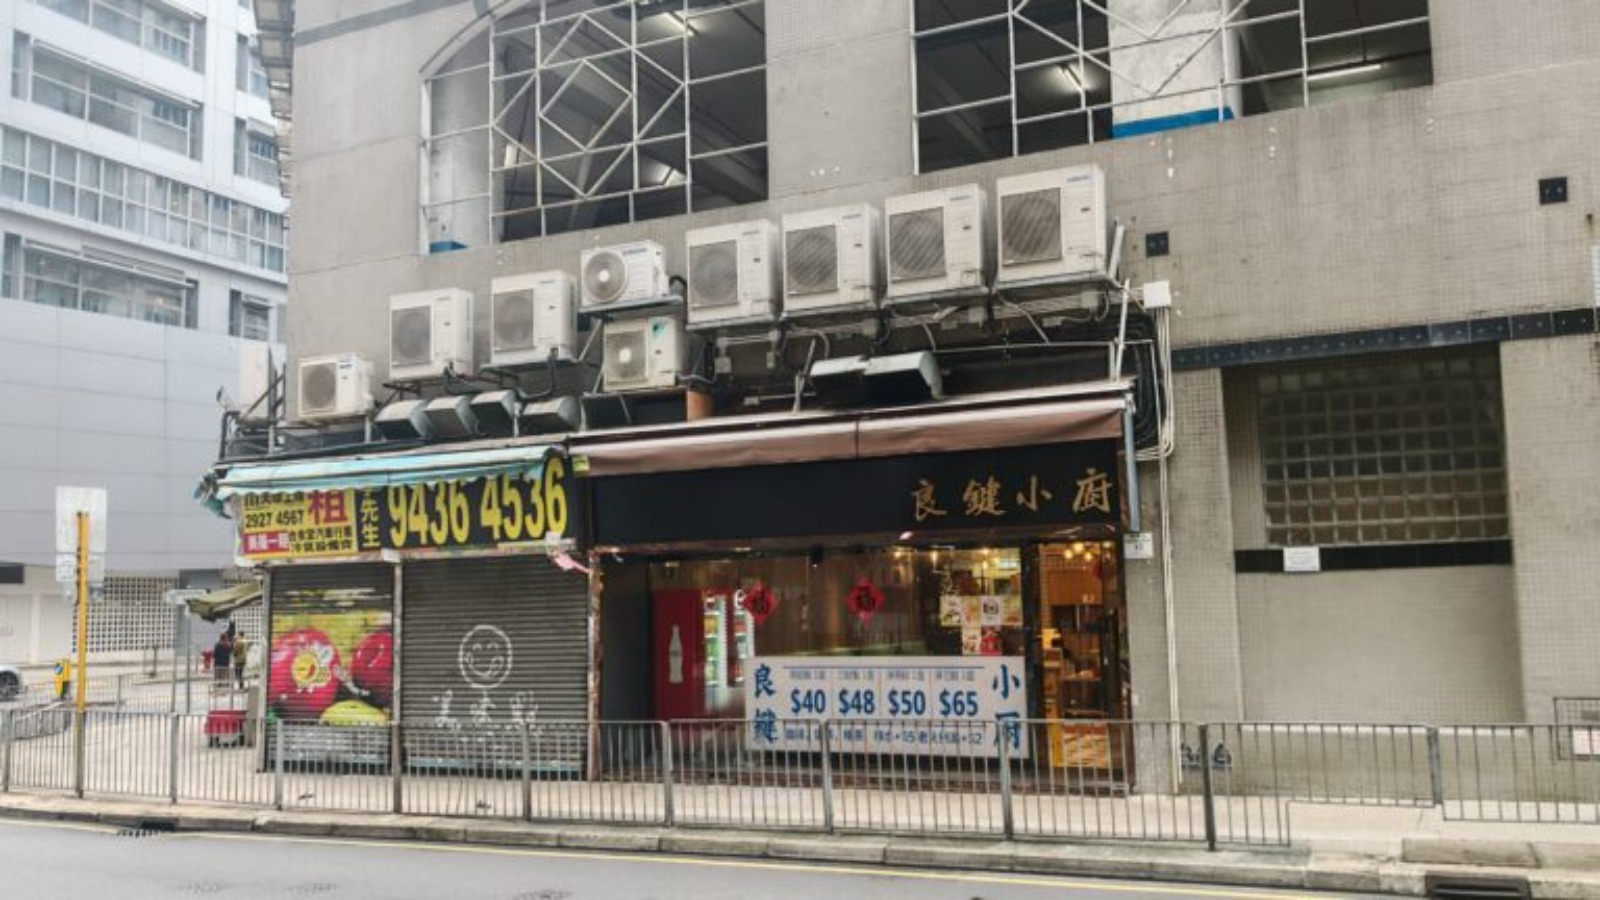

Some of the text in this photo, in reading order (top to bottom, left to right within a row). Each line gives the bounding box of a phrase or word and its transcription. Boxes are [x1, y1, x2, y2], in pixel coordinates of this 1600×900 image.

[387, 456, 567, 548] 9436 4536
[790, 688, 827, 715] $40
[838, 687, 876, 716] $48
[887, 688, 926, 717] $50
[938, 688, 978, 718] $65
